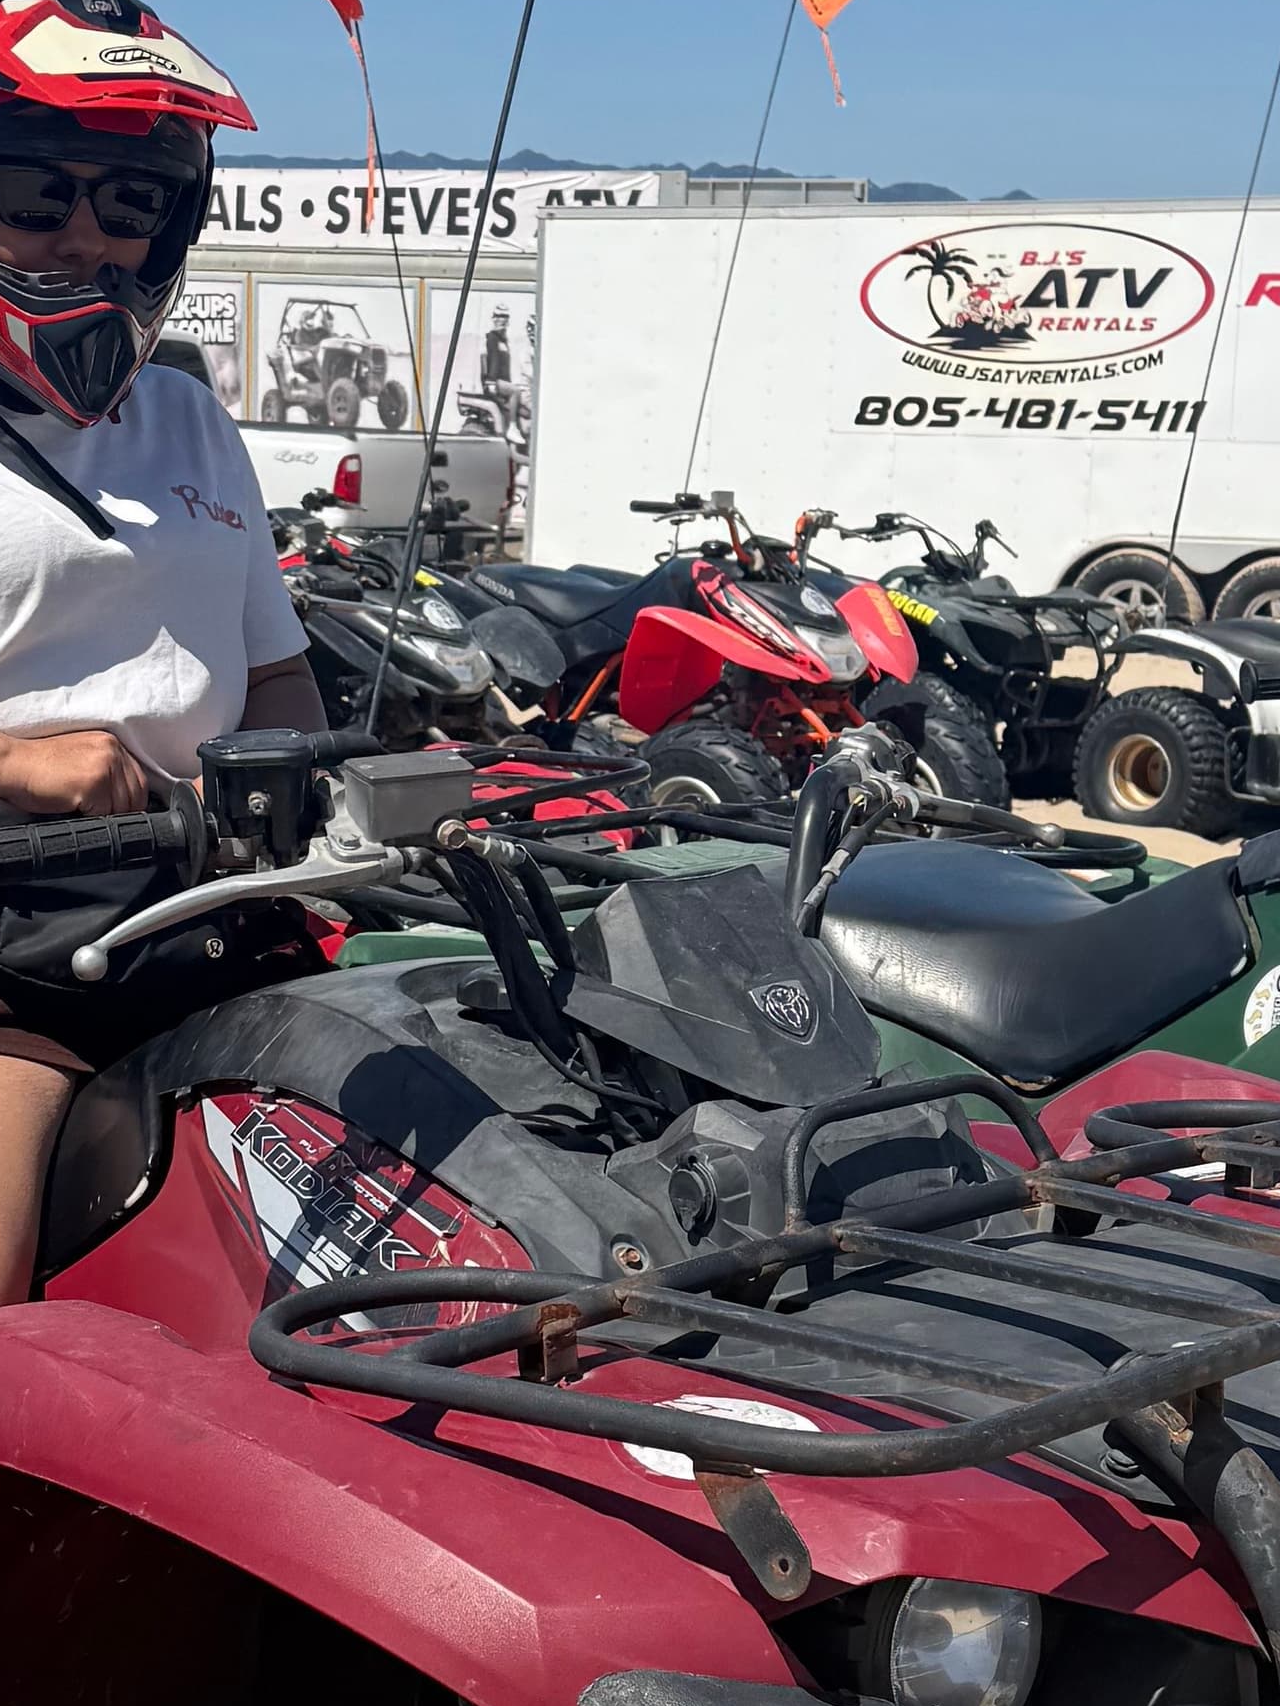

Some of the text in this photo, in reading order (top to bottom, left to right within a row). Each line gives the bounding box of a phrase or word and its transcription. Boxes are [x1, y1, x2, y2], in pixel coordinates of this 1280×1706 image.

[204, 185, 518, 238] ALS STEVE'S
[1021, 268, 1175, 309] ATV
[1037, 317, 1158, 332] RENTALS
[901, 350, 1165, 385] WWW.BJSATVRENTALS.COM
[854, 396, 1208, 433] 805-481-5411
[475, 572, 516, 601] HONDA
[231, 1108, 422, 1272] KODIAK
